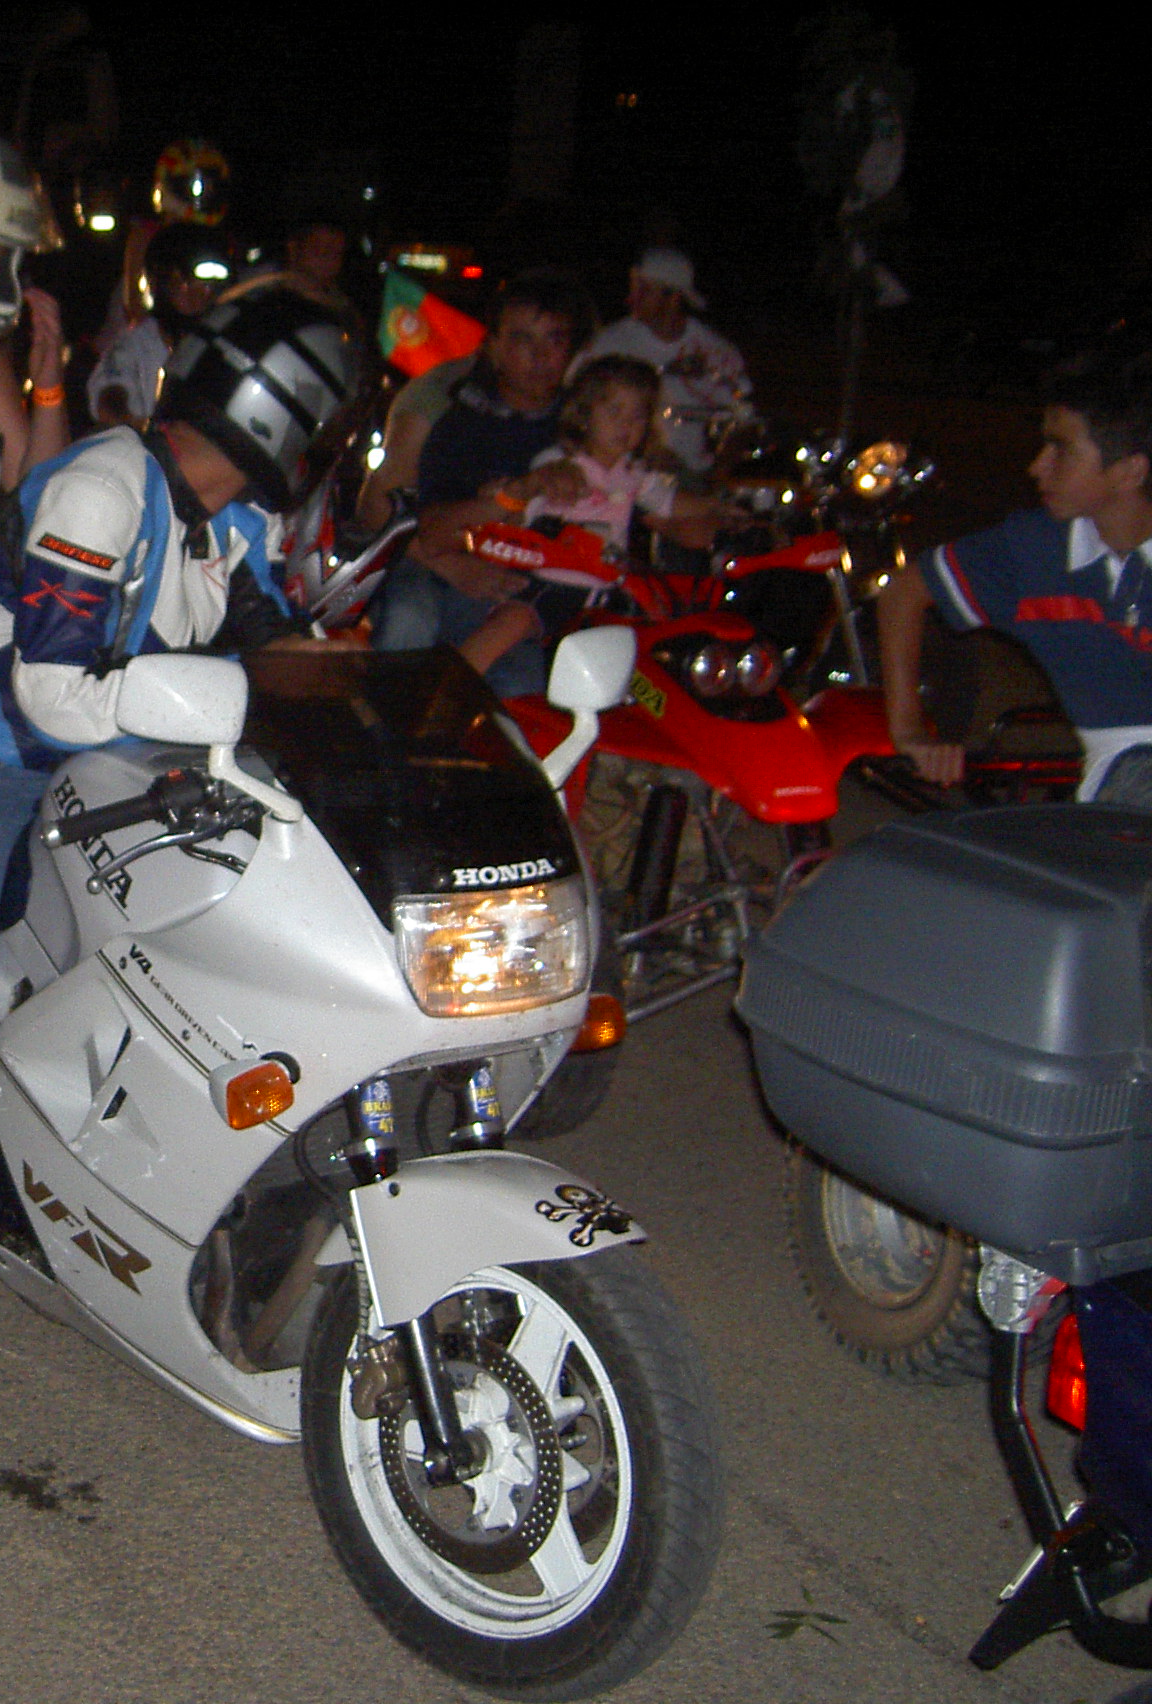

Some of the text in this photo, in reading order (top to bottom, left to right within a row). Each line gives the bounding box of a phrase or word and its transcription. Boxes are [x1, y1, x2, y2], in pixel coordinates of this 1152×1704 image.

[453, 859, 556, 887] HONDA
[128, 943, 154, 975] V4
[22, 1159, 153, 1297] VFR
